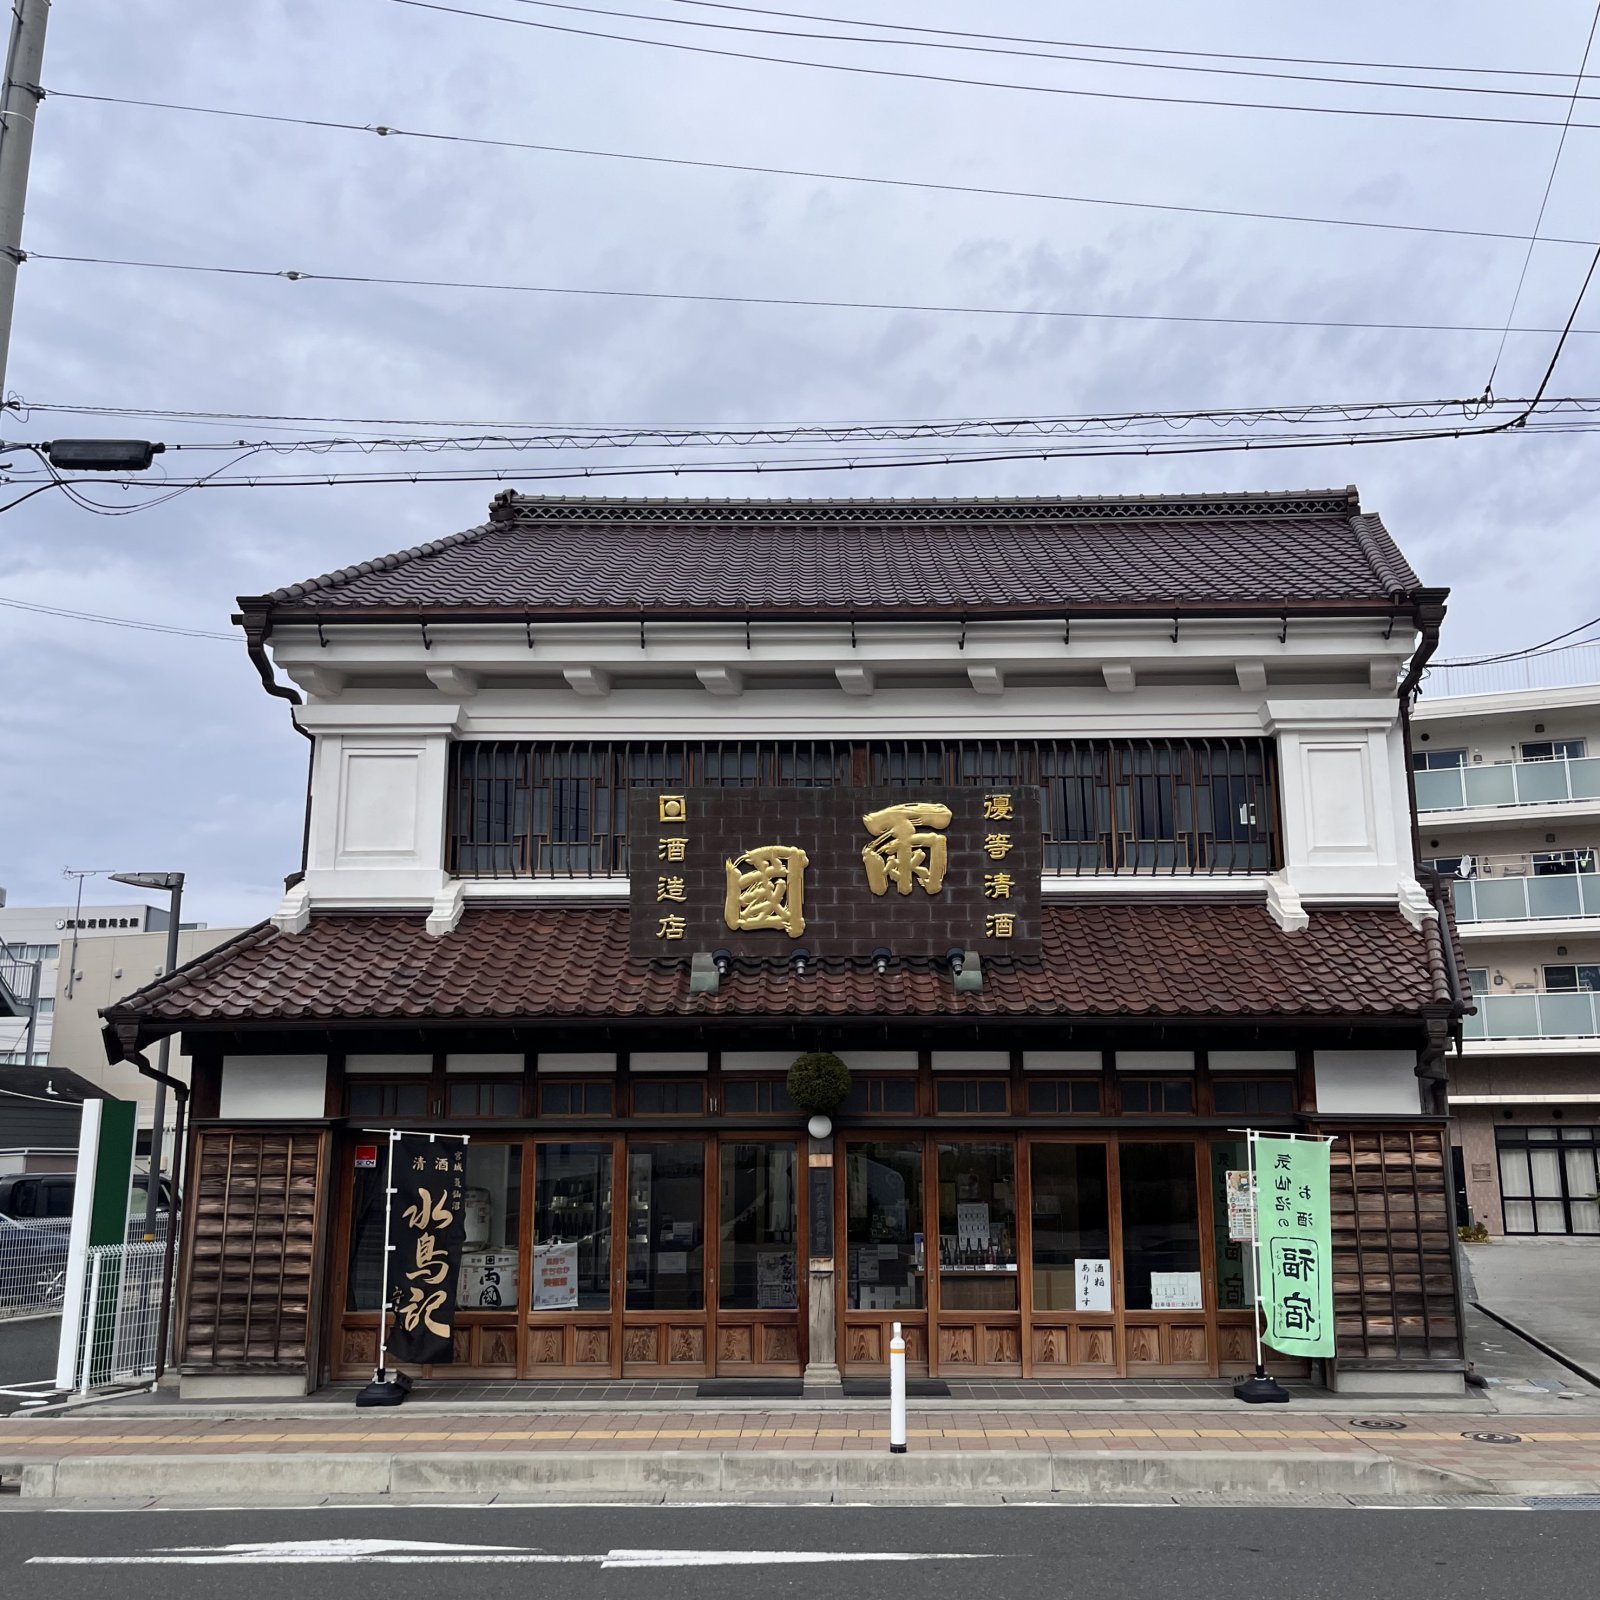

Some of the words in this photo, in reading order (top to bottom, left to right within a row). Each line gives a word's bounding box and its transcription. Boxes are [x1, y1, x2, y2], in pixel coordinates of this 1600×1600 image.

[656, 837, 689, 941] 酒造店
[983, 794, 1016, 938] 優等清酒
[412, 1156, 449, 1172] 清酒
[402, 1187, 454, 1339] 水鳥記
[1081, 1264, 1091, 1307] あります
[1094, 1263, 1105, 1287] 酒粕
